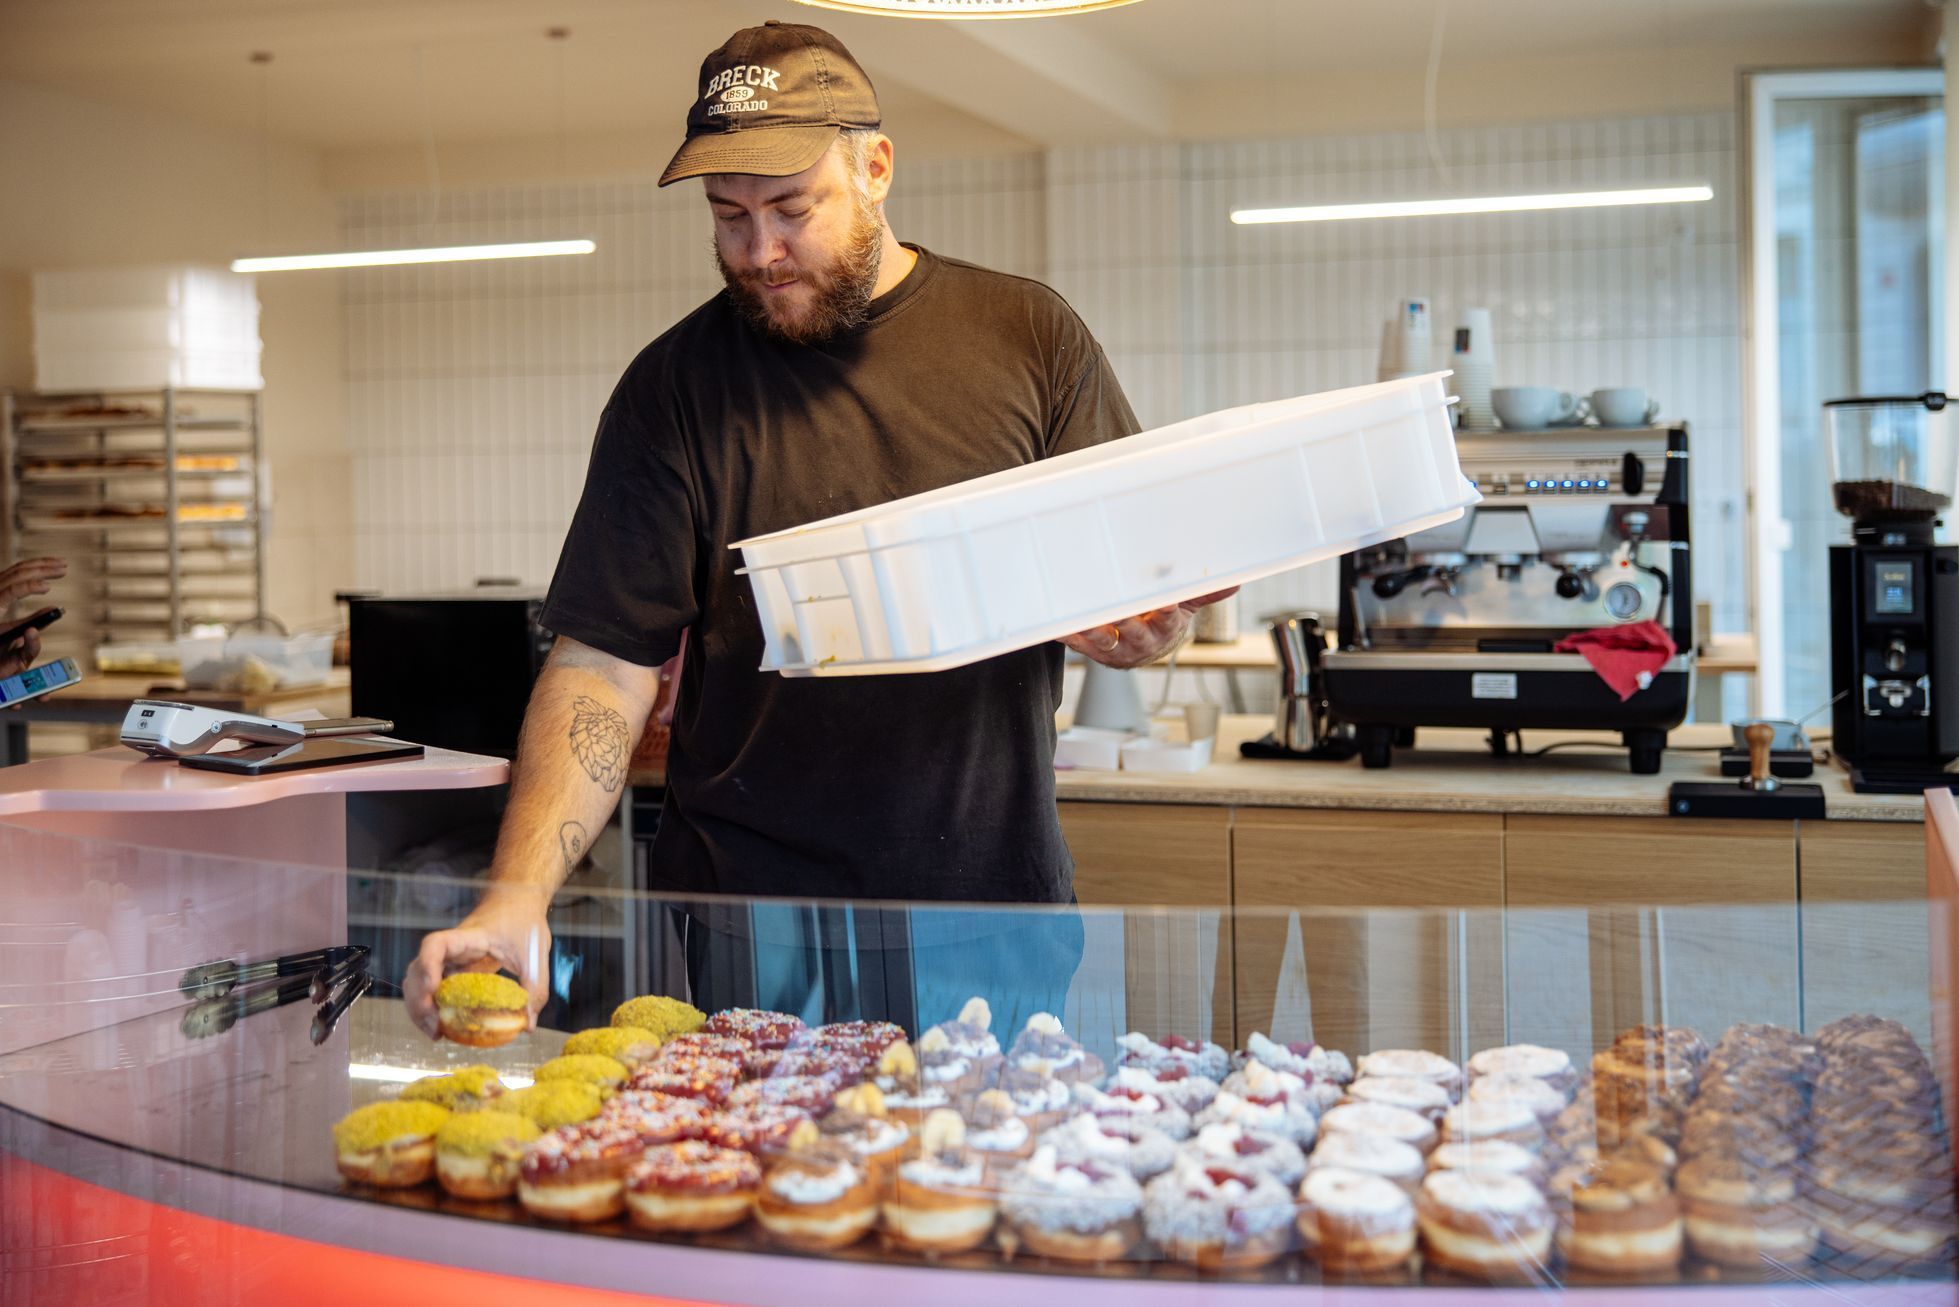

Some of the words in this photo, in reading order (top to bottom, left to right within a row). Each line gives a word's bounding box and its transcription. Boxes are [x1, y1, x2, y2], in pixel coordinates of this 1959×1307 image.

[704, 65, 781, 100] BRECK
[726, 89, 748, 99] 1859
[707, 100, 768, 116] COLORADO
